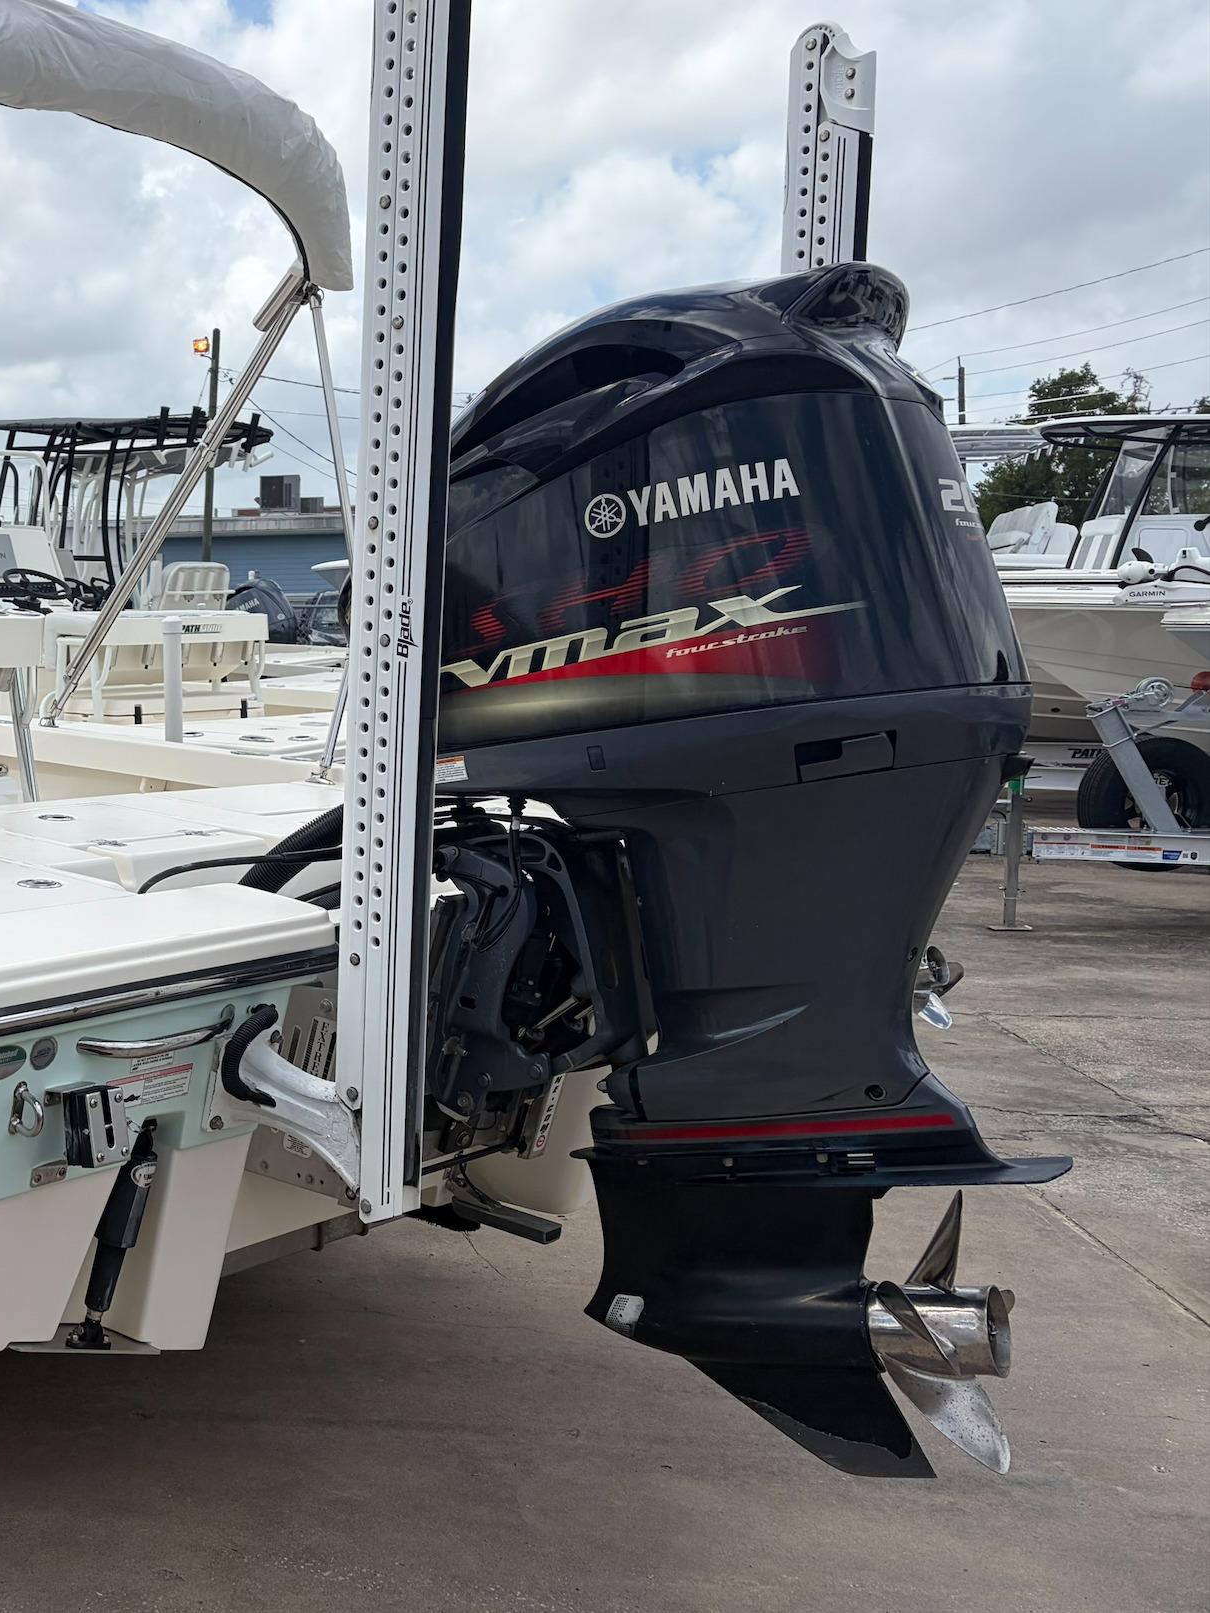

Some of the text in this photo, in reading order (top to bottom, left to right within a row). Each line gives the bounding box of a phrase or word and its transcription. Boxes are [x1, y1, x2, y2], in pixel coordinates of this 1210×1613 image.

[627, 458, 800, 527] YAMAHA
[396, 601, 419, 659] Blade
[666, 626, 808, 658] fourstroke
